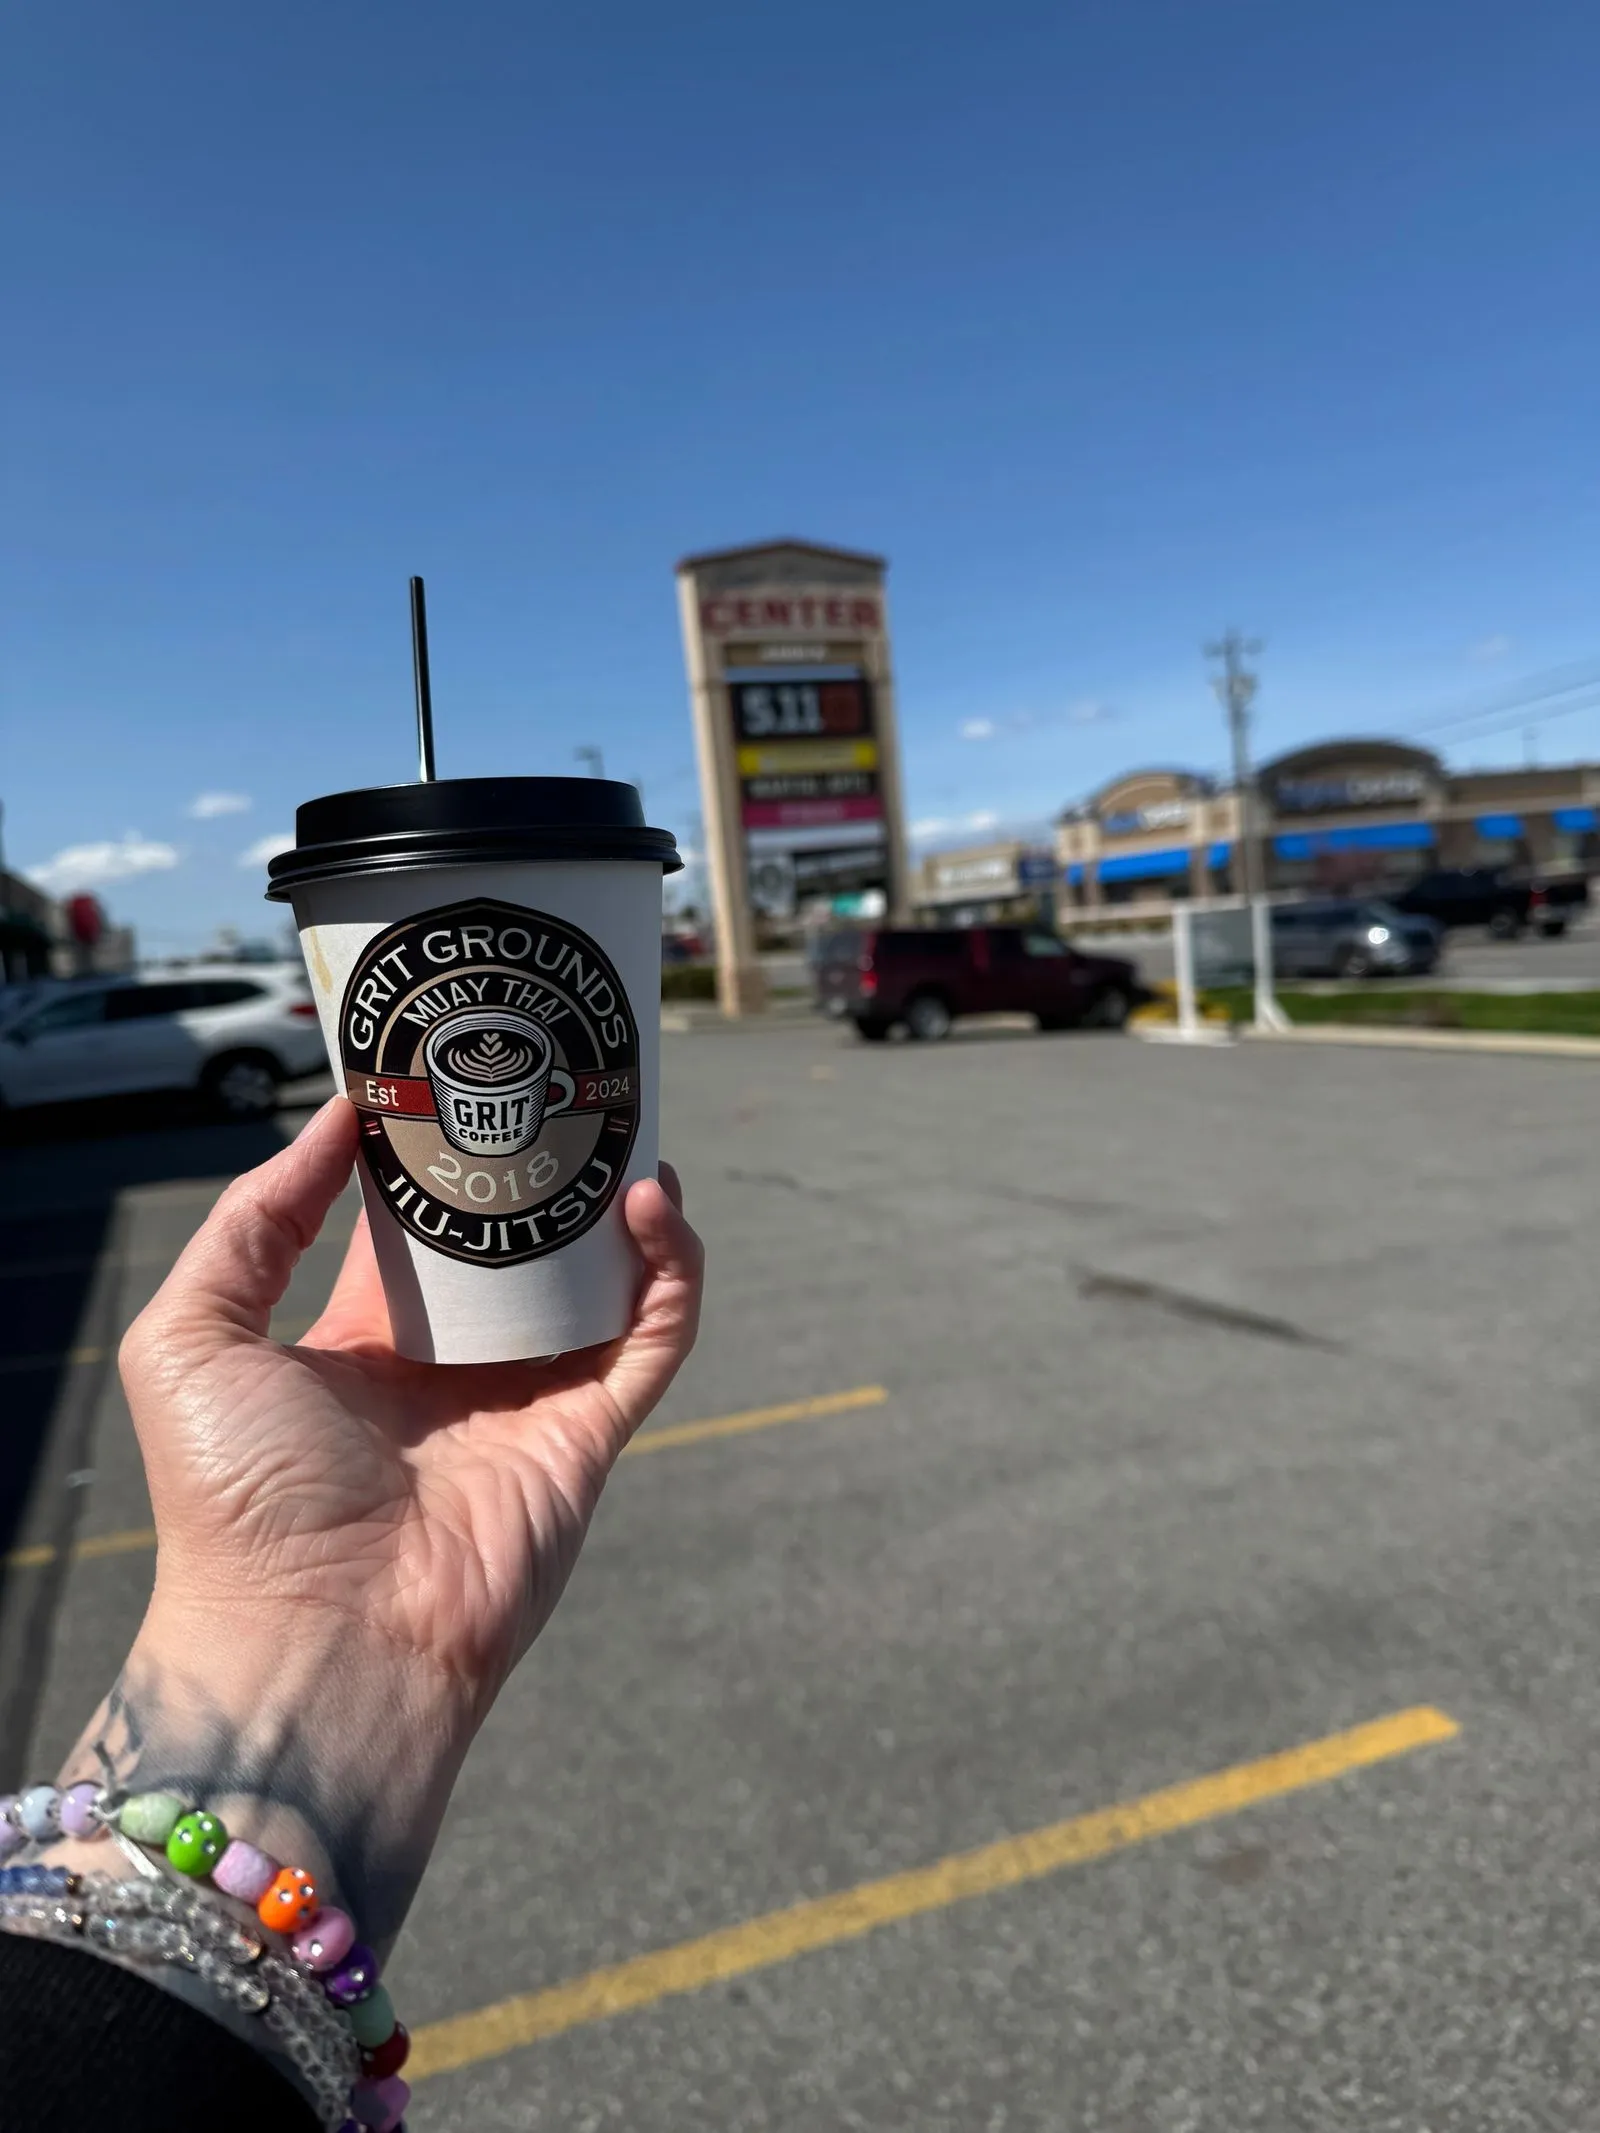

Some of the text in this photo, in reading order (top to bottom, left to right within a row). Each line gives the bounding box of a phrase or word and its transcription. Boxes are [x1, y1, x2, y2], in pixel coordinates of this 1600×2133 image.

[702, 598, 881, 632] CENTER
[350, 925, 628, 1050] GRIT GROUNDS
[402, 977, 570, 1028] MUAY THAI
[366, 1079, 399, 1107] Est
[586, 1076, 630, 1101] 2024
[453, 1098, 530, 1131] GRIT
[458, 1127, 523, 1144] COFFEE
[427, 1150, 559, 1203] 2018
[378, 1157, 612, 1251] JIU-JITSU
